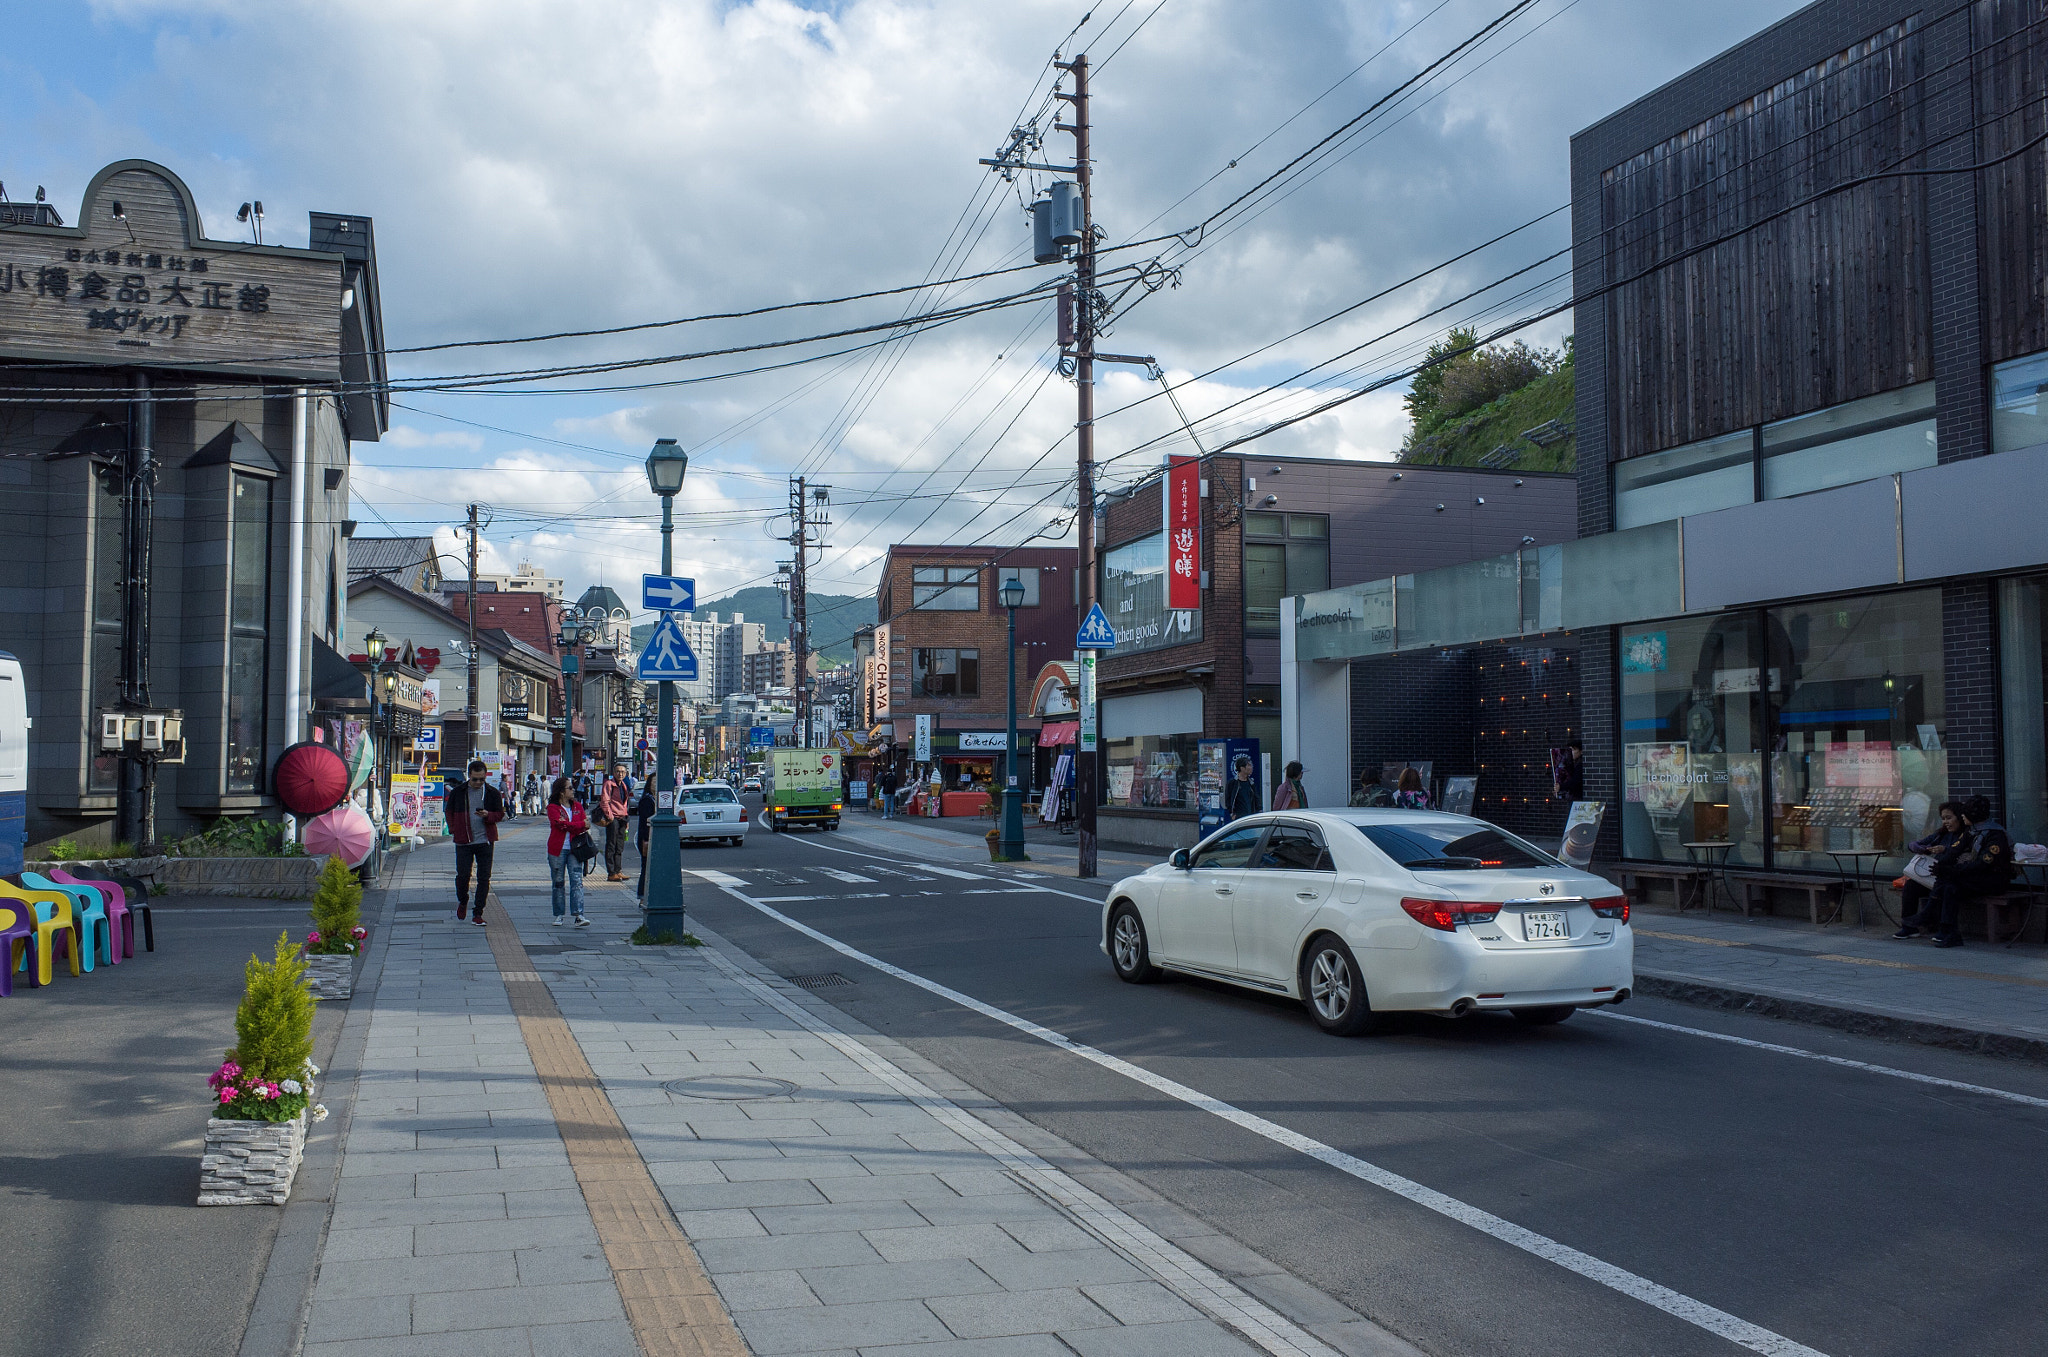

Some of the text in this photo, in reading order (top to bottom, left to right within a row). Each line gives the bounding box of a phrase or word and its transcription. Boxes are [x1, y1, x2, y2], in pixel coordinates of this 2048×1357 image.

[1174, 528, 1194, 578] 遊膳
[1120, 593, 1134, 613] and
[1310, 607, 1352, 627] chocolat
[1135, 618, 1159, 644] goods
[1371, 630, 1392, 642] LeTAO
[878, 630, 886, 661] SNOOPY
[876, 663, 888, 710] CHA-YA
[480, 712, 492, 732] 地酒
[620, 729, 630, 756] 北一硝子
[783, 767, 825, 777] スジャータ
[1647, 770, 1709, 784] le chocolat
[1547, 913, 1559, 921] 330
[1534, 921, 1567, 938] 72-61
